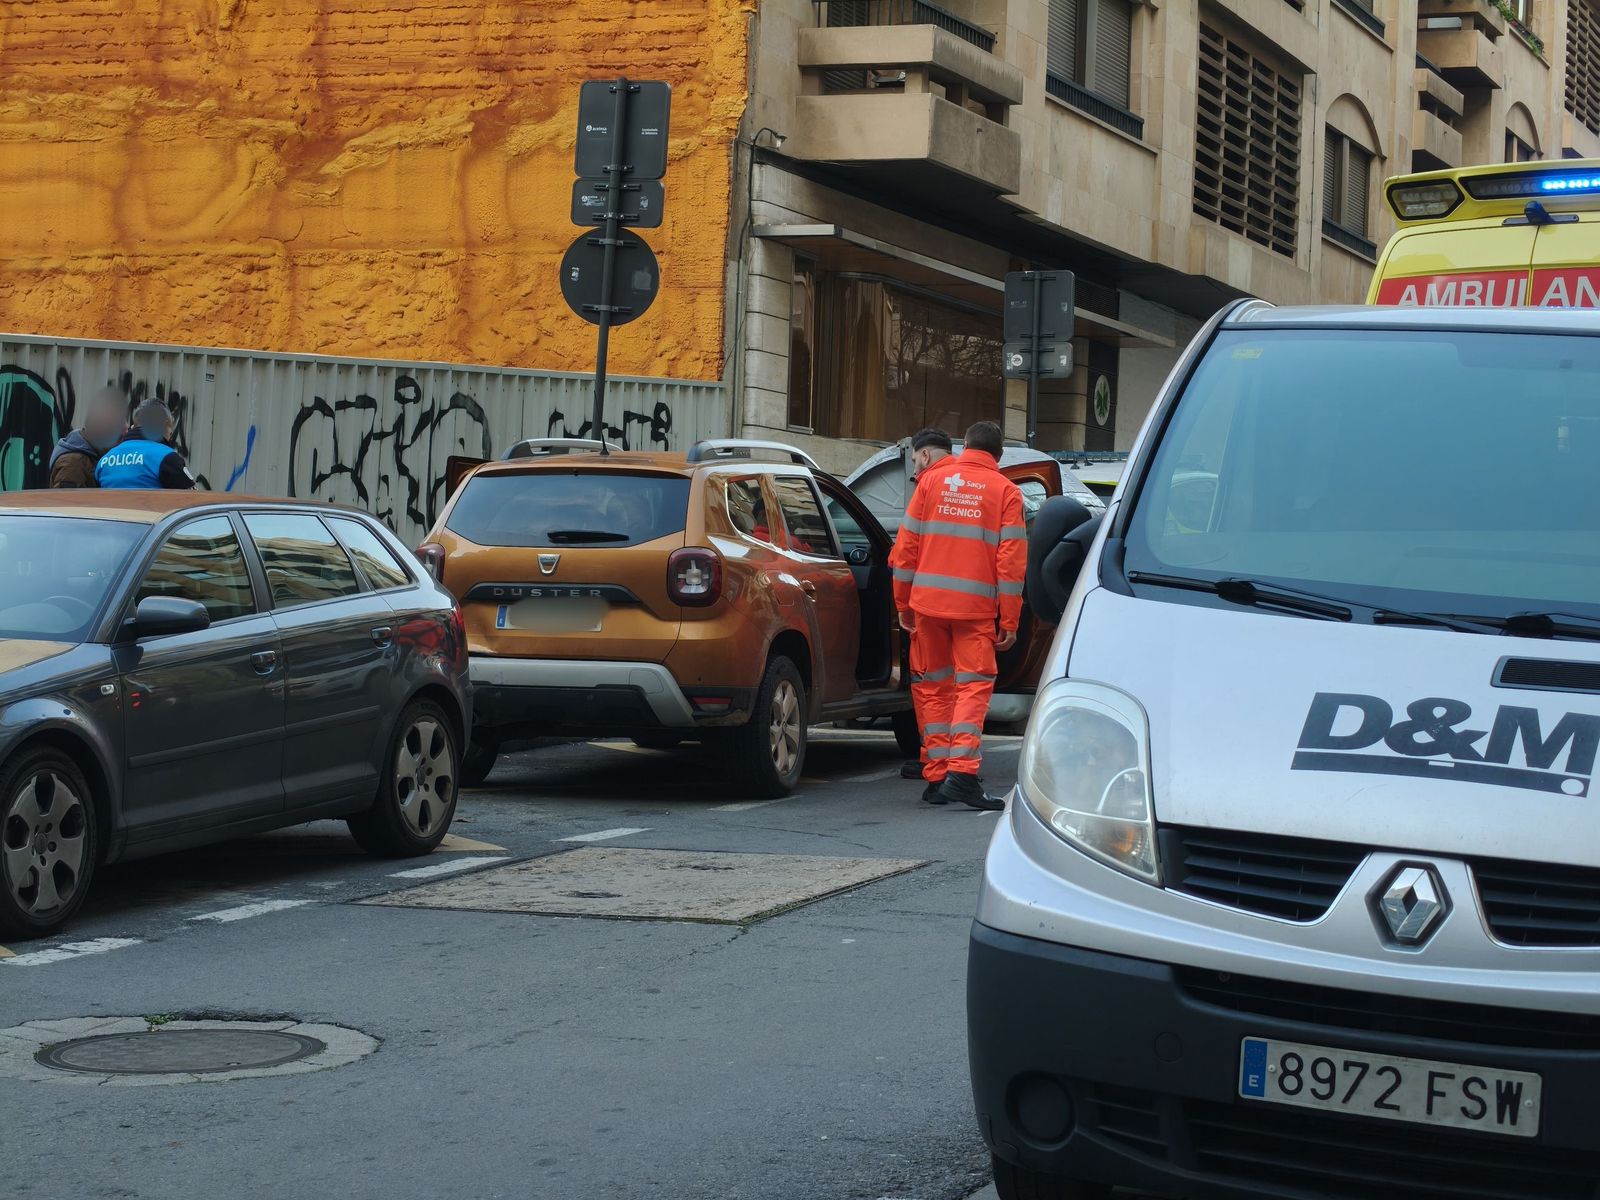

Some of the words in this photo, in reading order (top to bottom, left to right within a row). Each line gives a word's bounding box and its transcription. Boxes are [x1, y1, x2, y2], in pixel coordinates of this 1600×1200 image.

[100, 451, 144, 468] POLICÍA
[941, 490, 983, 501] EMERGENCIAS
[943, 496, 979, 506] SANITARIAS
[937, 504, 982, 518] TÉCNICO
[493, 587, 601, 597] DUSTER
[1296, 692, 1600, 776] D&M
[1247, 1074, 1259, 1088] E
[1277, 1052, 1403, 1112] 8972
[1425, 1070, 1523, 1126] FSW
